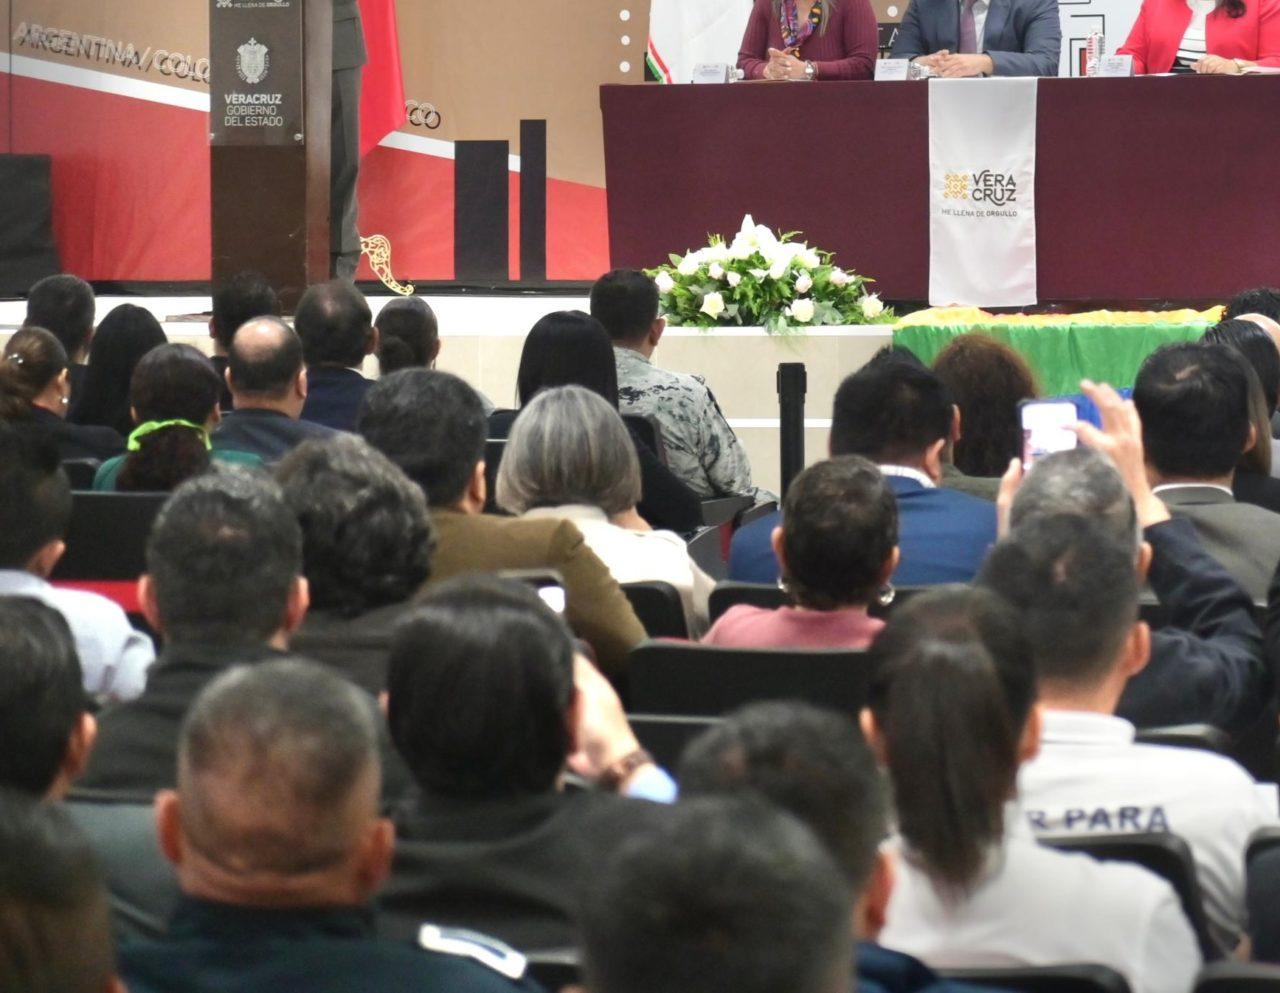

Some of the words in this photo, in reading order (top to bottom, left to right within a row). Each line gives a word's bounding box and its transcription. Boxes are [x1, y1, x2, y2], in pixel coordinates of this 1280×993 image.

[224, 94, 282, 105] VERACRUZ
[226, 105, 277, 116] GOBIERNO
[224, 116, 244, 127] DEL
[245, 116, 283, 127] ESTADO
[972, 170, 1017, 188] VERA
[971, 188, 1017, 207] CRUZ
[1064, 805, 1170, 831] PARA
